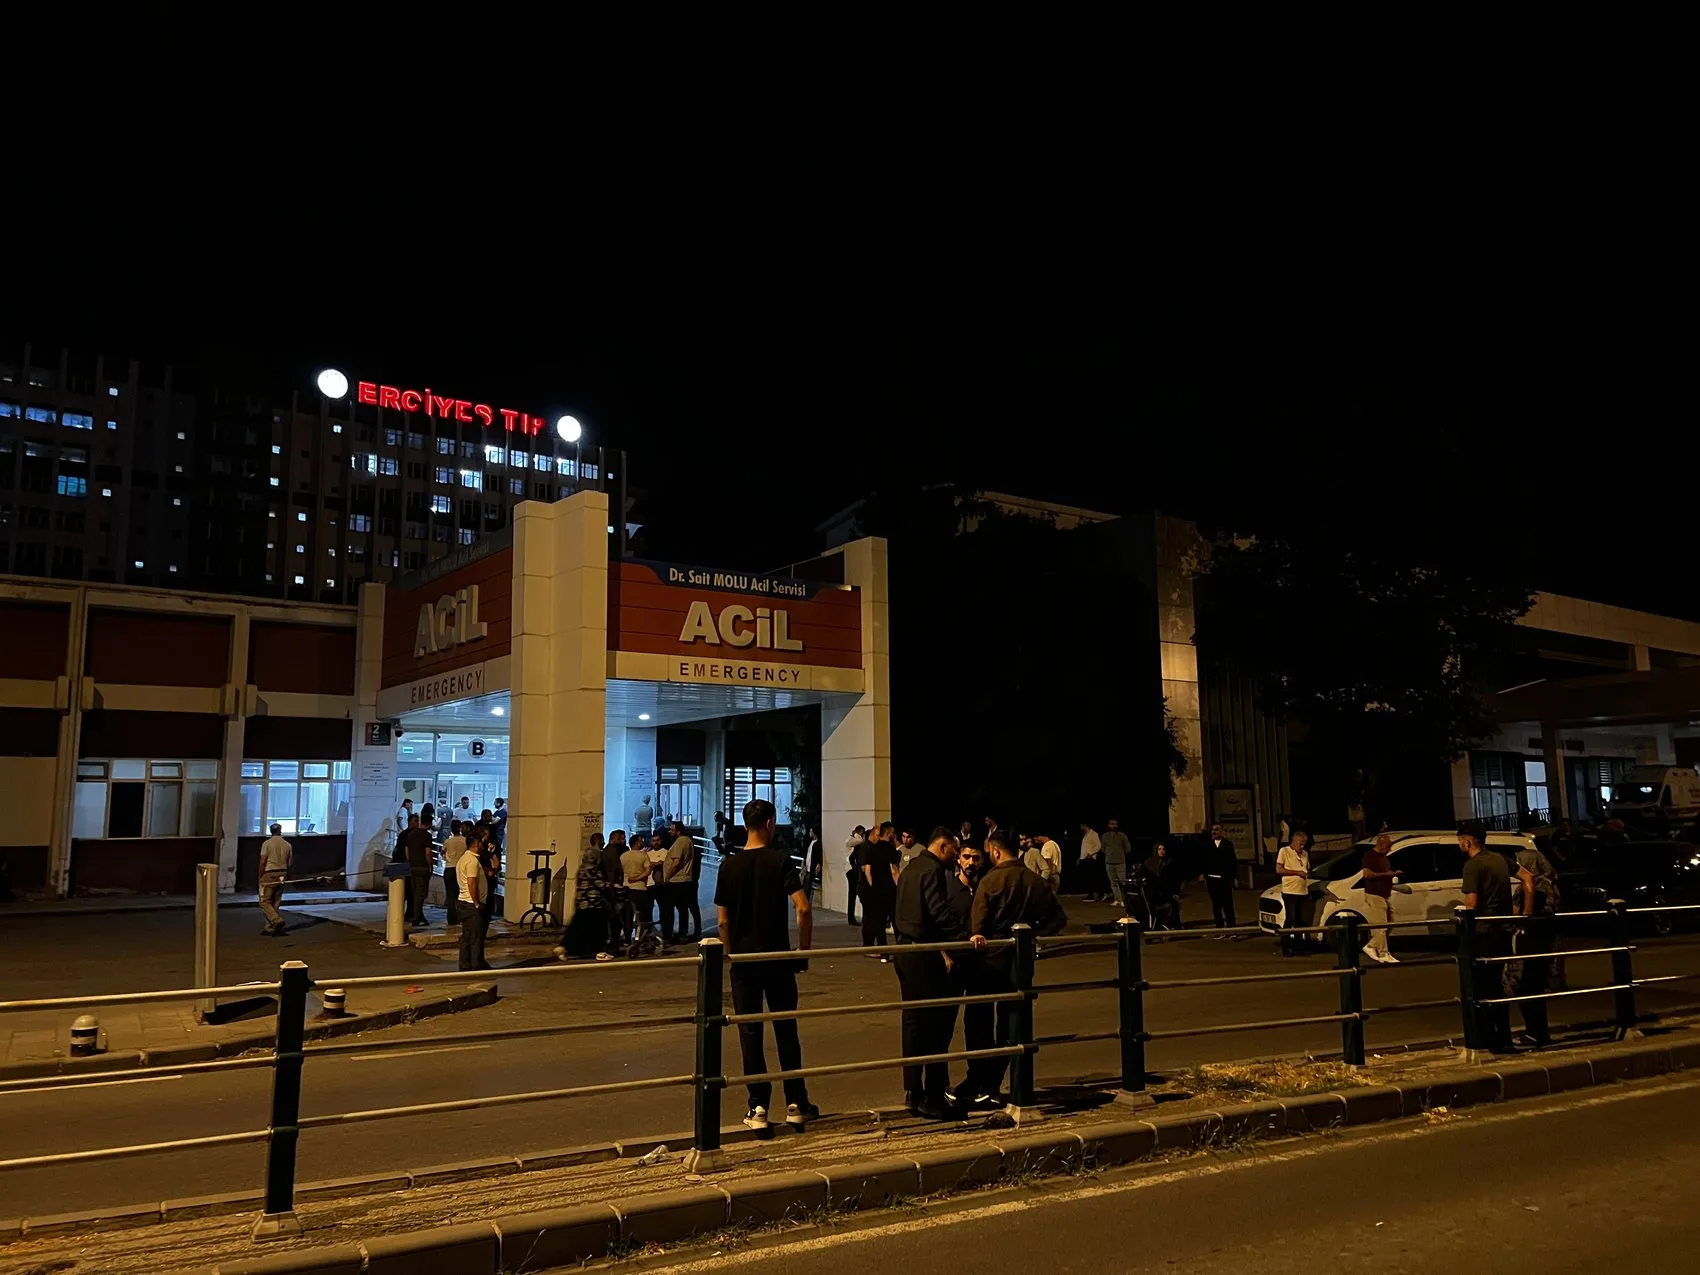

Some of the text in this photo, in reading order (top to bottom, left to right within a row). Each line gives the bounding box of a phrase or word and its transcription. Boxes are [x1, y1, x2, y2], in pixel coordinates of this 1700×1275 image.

[669, 567, 806, 597] Dr. Sait MOLU Acil Servisi
[680, 662, 800, 682] EMERGENCY
[411, 670, 482, 704] EMERGENCY
[472, 741, 484, 756] B
